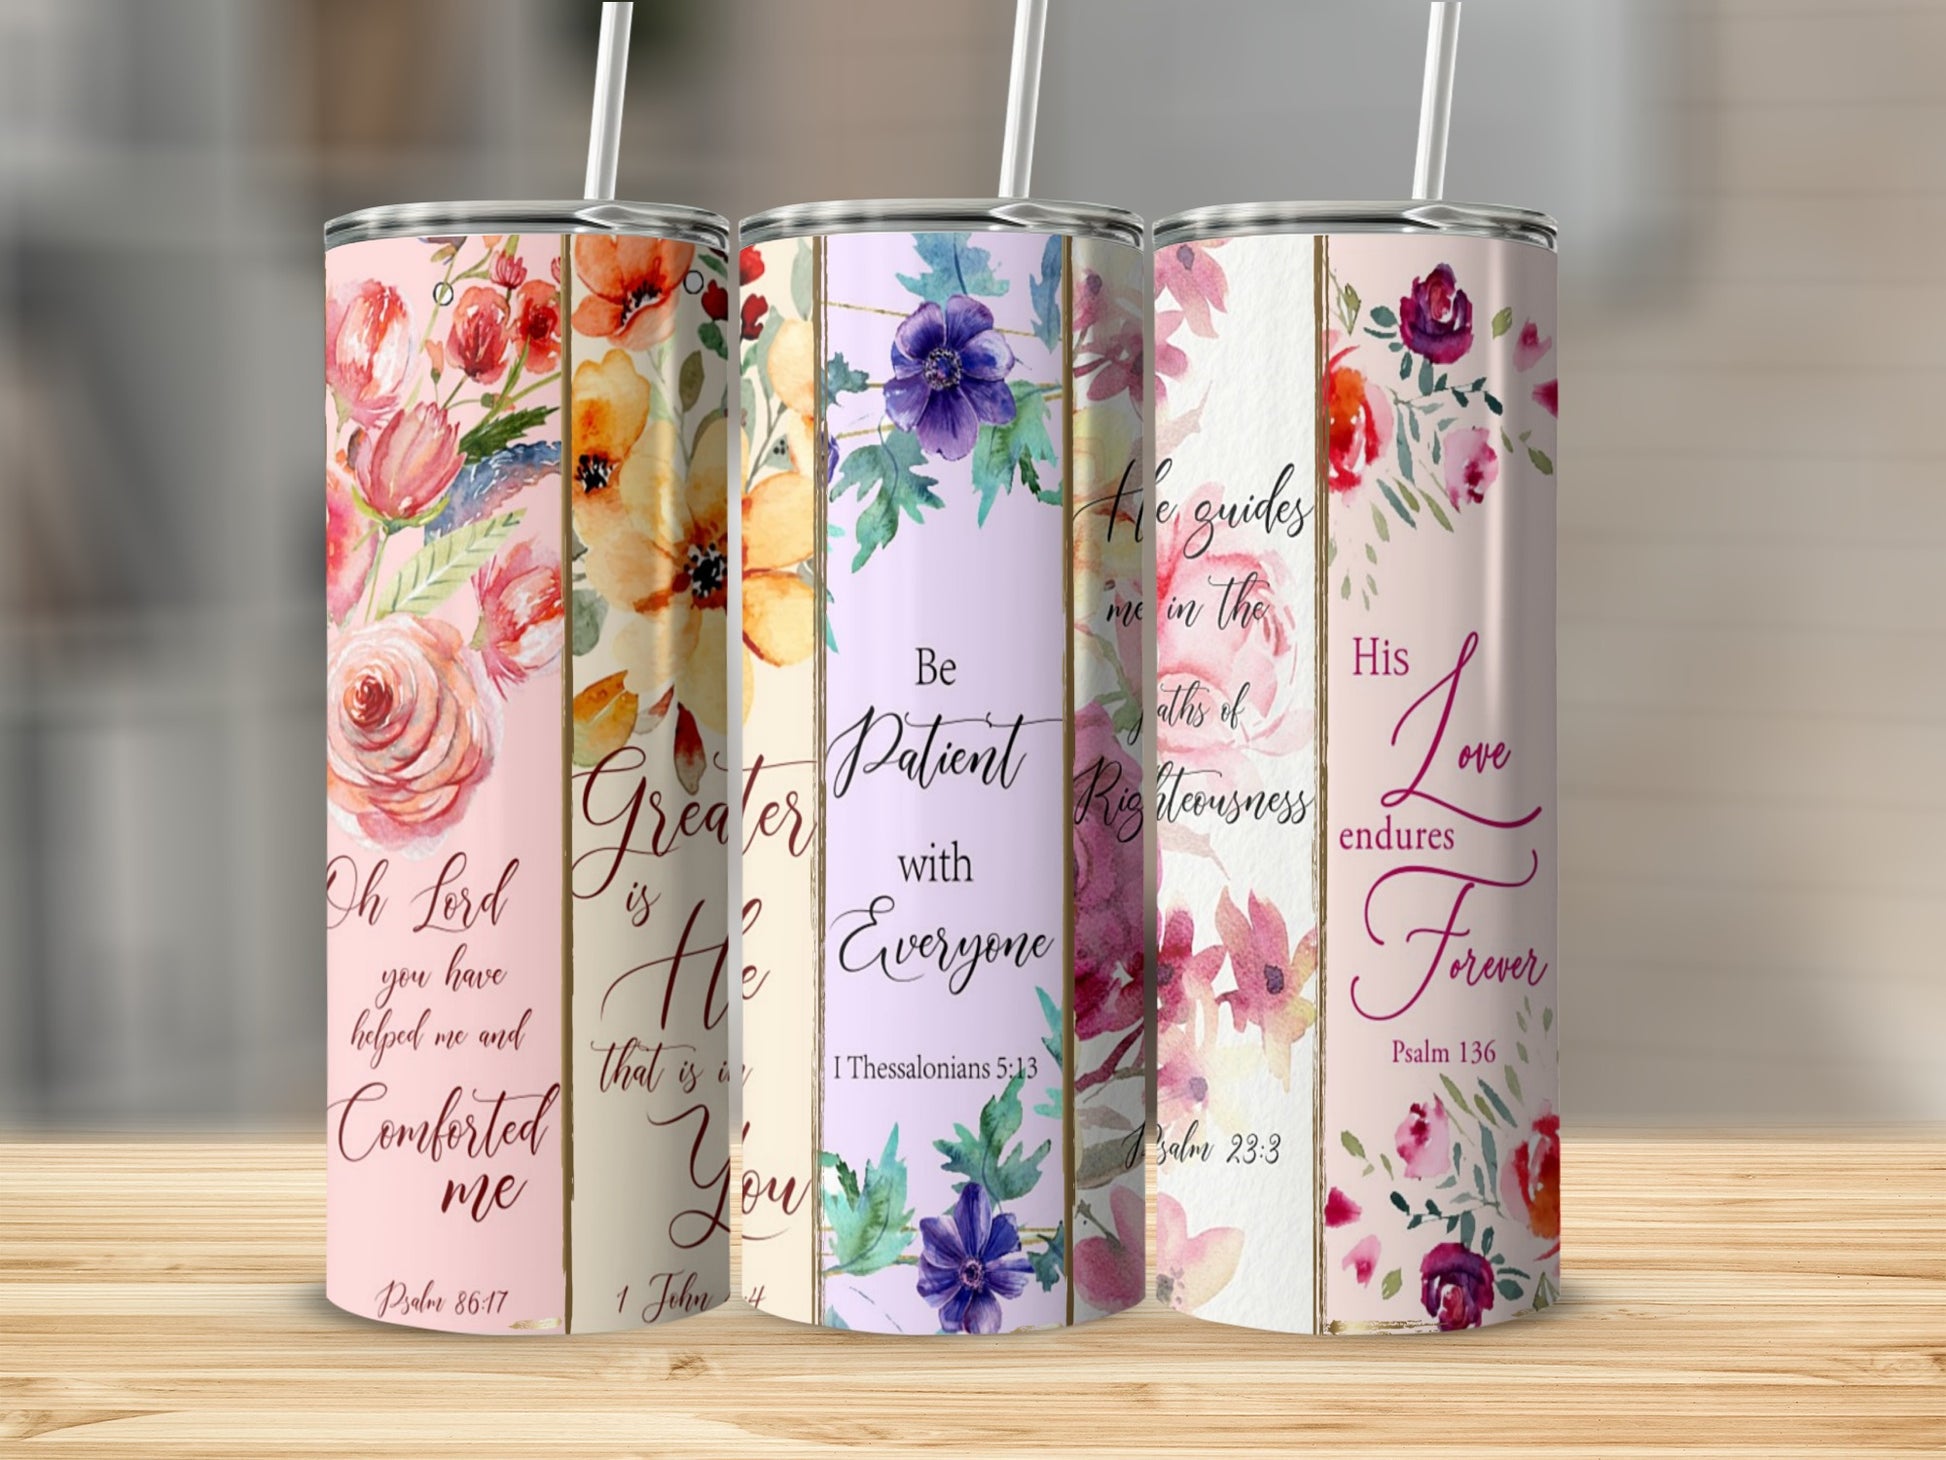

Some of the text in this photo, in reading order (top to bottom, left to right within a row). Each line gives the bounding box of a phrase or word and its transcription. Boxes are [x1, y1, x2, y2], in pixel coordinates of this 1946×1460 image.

[1073, 458, 1315, 560] He guides
[1166, 596, 1204, 628] in
[1208, 571, 1271, 630] the
[915, 647, 957, 686] Be
[1352, 636, 1410, 677] His
[1221, 681, 1251, 729] of
[1381, 631, 1542, 829] Love
[826, 705, 1063, 798] Patient
[572, 746, 817, 899] Greater
[1339, 814, 1455, 850] endures
[897, 840, 974, 883] with
[327, 851, 520, 933] Oh Lord
[626, 881, 661, 927] is
[830, 895, 1055, 995] Everyone
[1350, 848, 1548, 1021] Forever
[375, 943, 508, 1010] you have
[350, 1008, 533, 1070] helped me and
[590, 1037, 696, 1093] that
[679, 1060, 703, 1094] is
[833, 1054, 1038, 1080] I Thessalonians 5:13
[1391, 1038, 1497, 1065] Psalm 136
[327, 1081, 561, 1163] Comforted
[1226, 1133, 1282, 1165] 23:3
[441, 1173, 528, 1223] me
[375, 1279, 509, 1318] Psalm 86:17
[617, 1285, 629, 1313] 1
[642, 1269, 713, 1324] John
